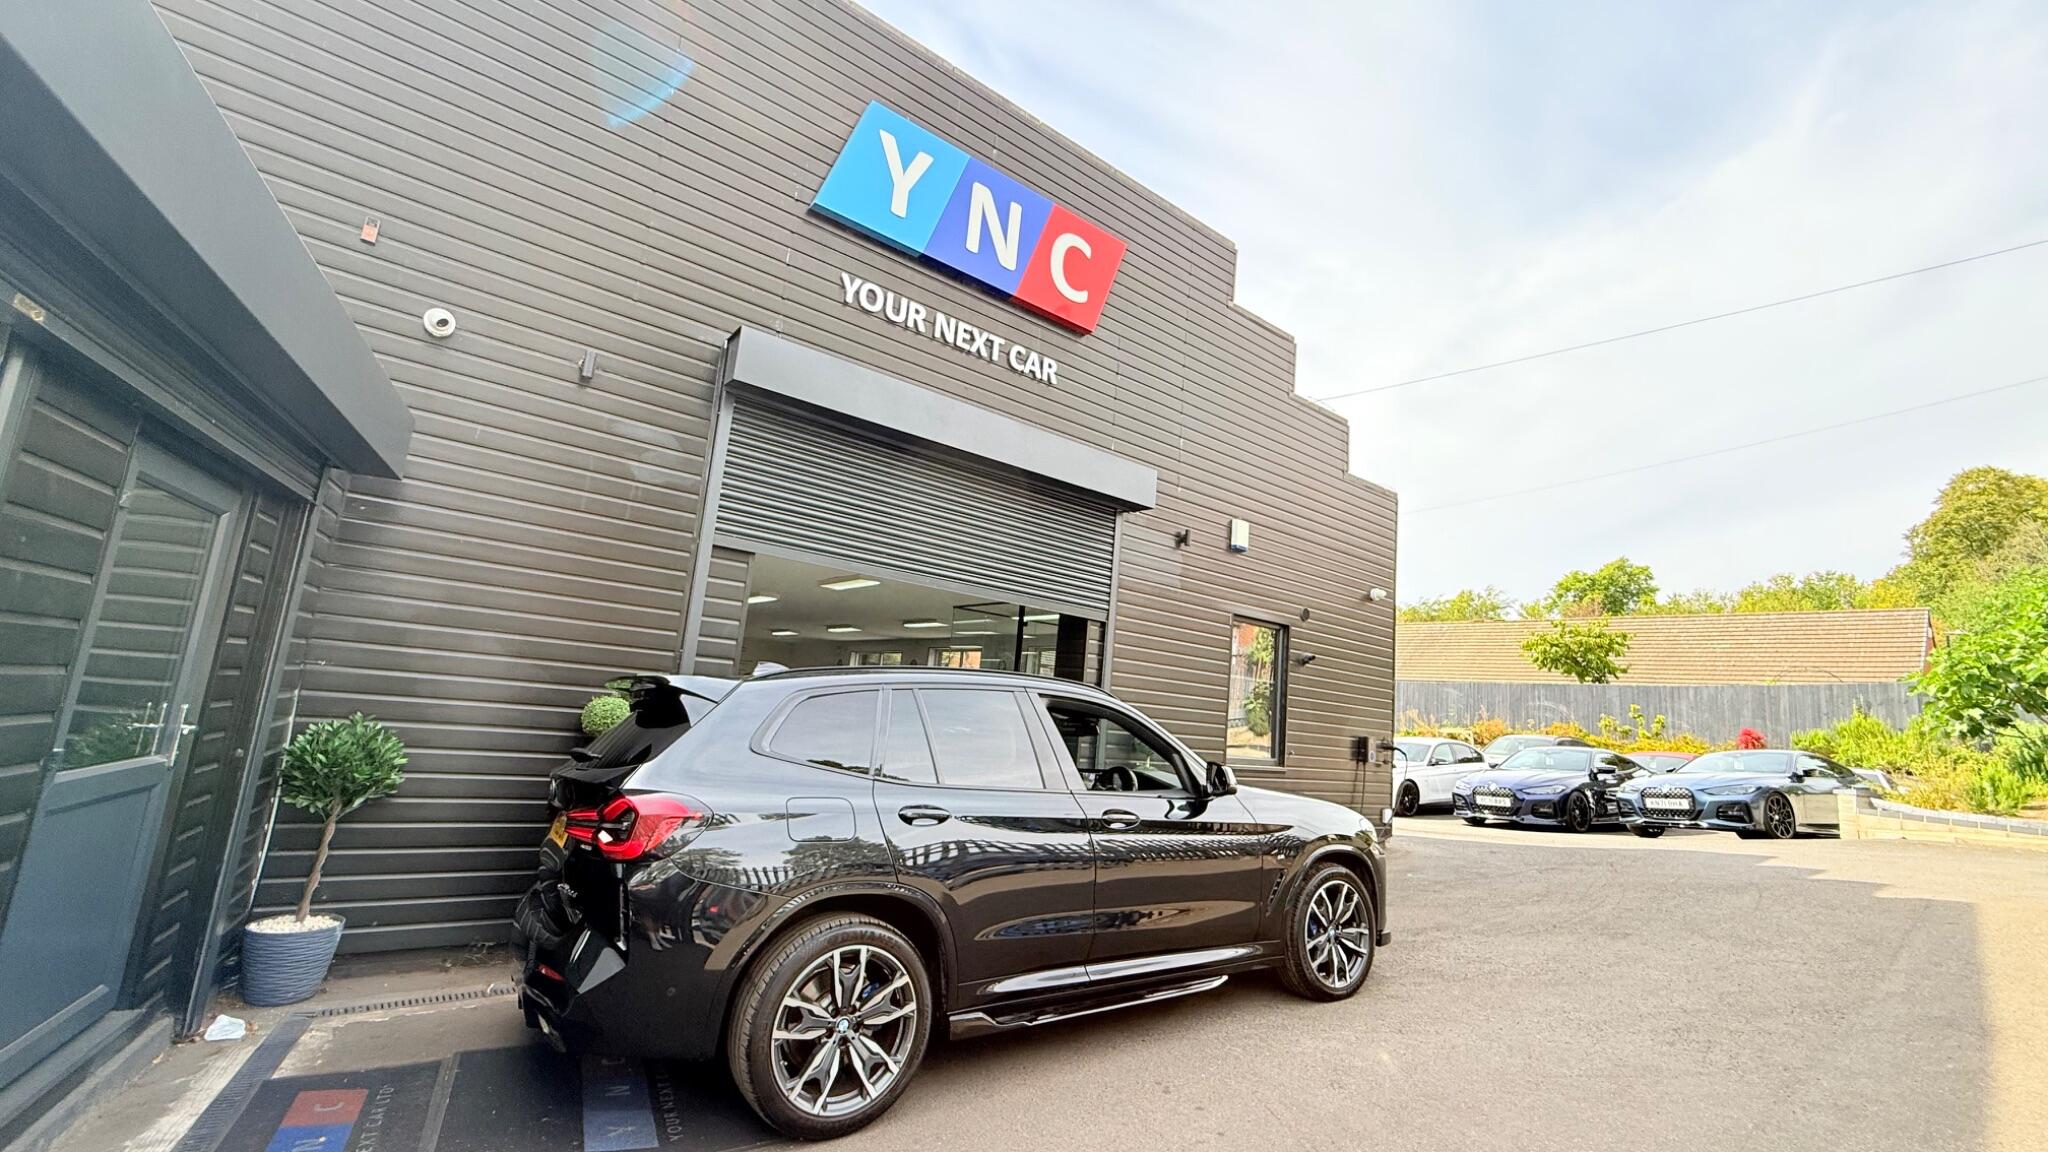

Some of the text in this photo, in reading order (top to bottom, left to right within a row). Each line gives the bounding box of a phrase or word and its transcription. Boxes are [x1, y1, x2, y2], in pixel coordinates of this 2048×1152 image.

[879, 128, 1092, 304] YNC
[840, 271, 1058, 385] YOUR NEXT CAR
[663, 1110, 685, 1142] YOUR
